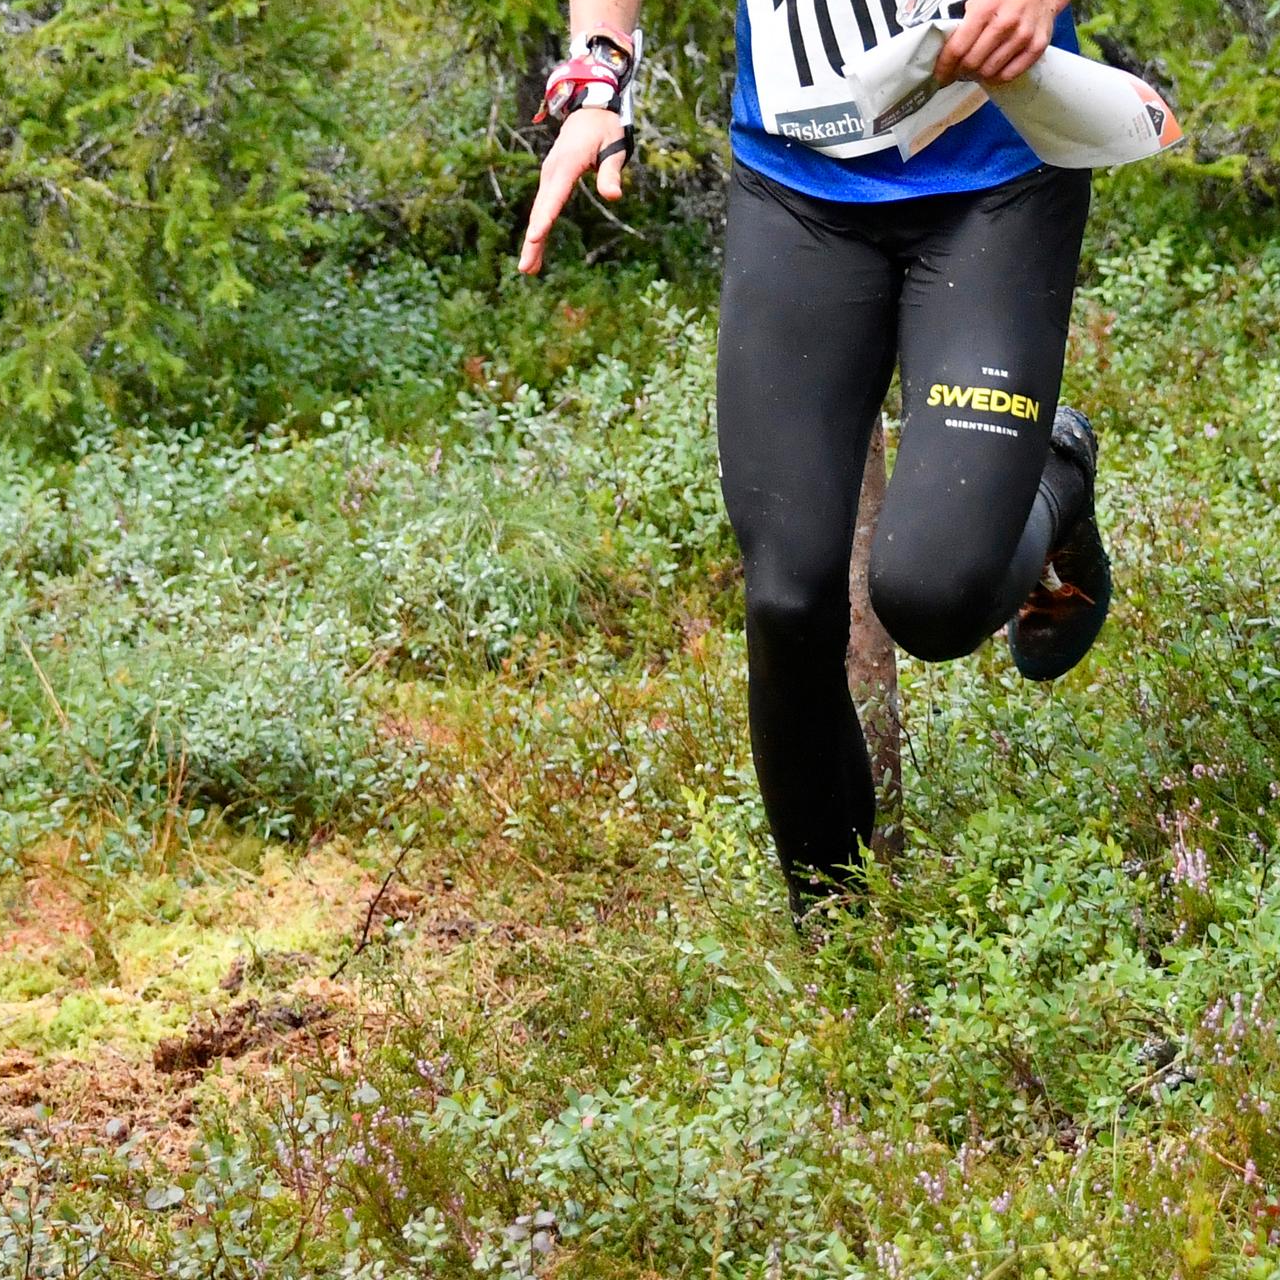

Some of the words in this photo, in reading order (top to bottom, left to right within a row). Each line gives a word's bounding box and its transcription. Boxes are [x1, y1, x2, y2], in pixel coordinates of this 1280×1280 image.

[981, 367, 1009, 378] TEAM
[927, 383, 1039, 423] SWEDEN
[945, 419, 1019, 437] ORIENTEERING
